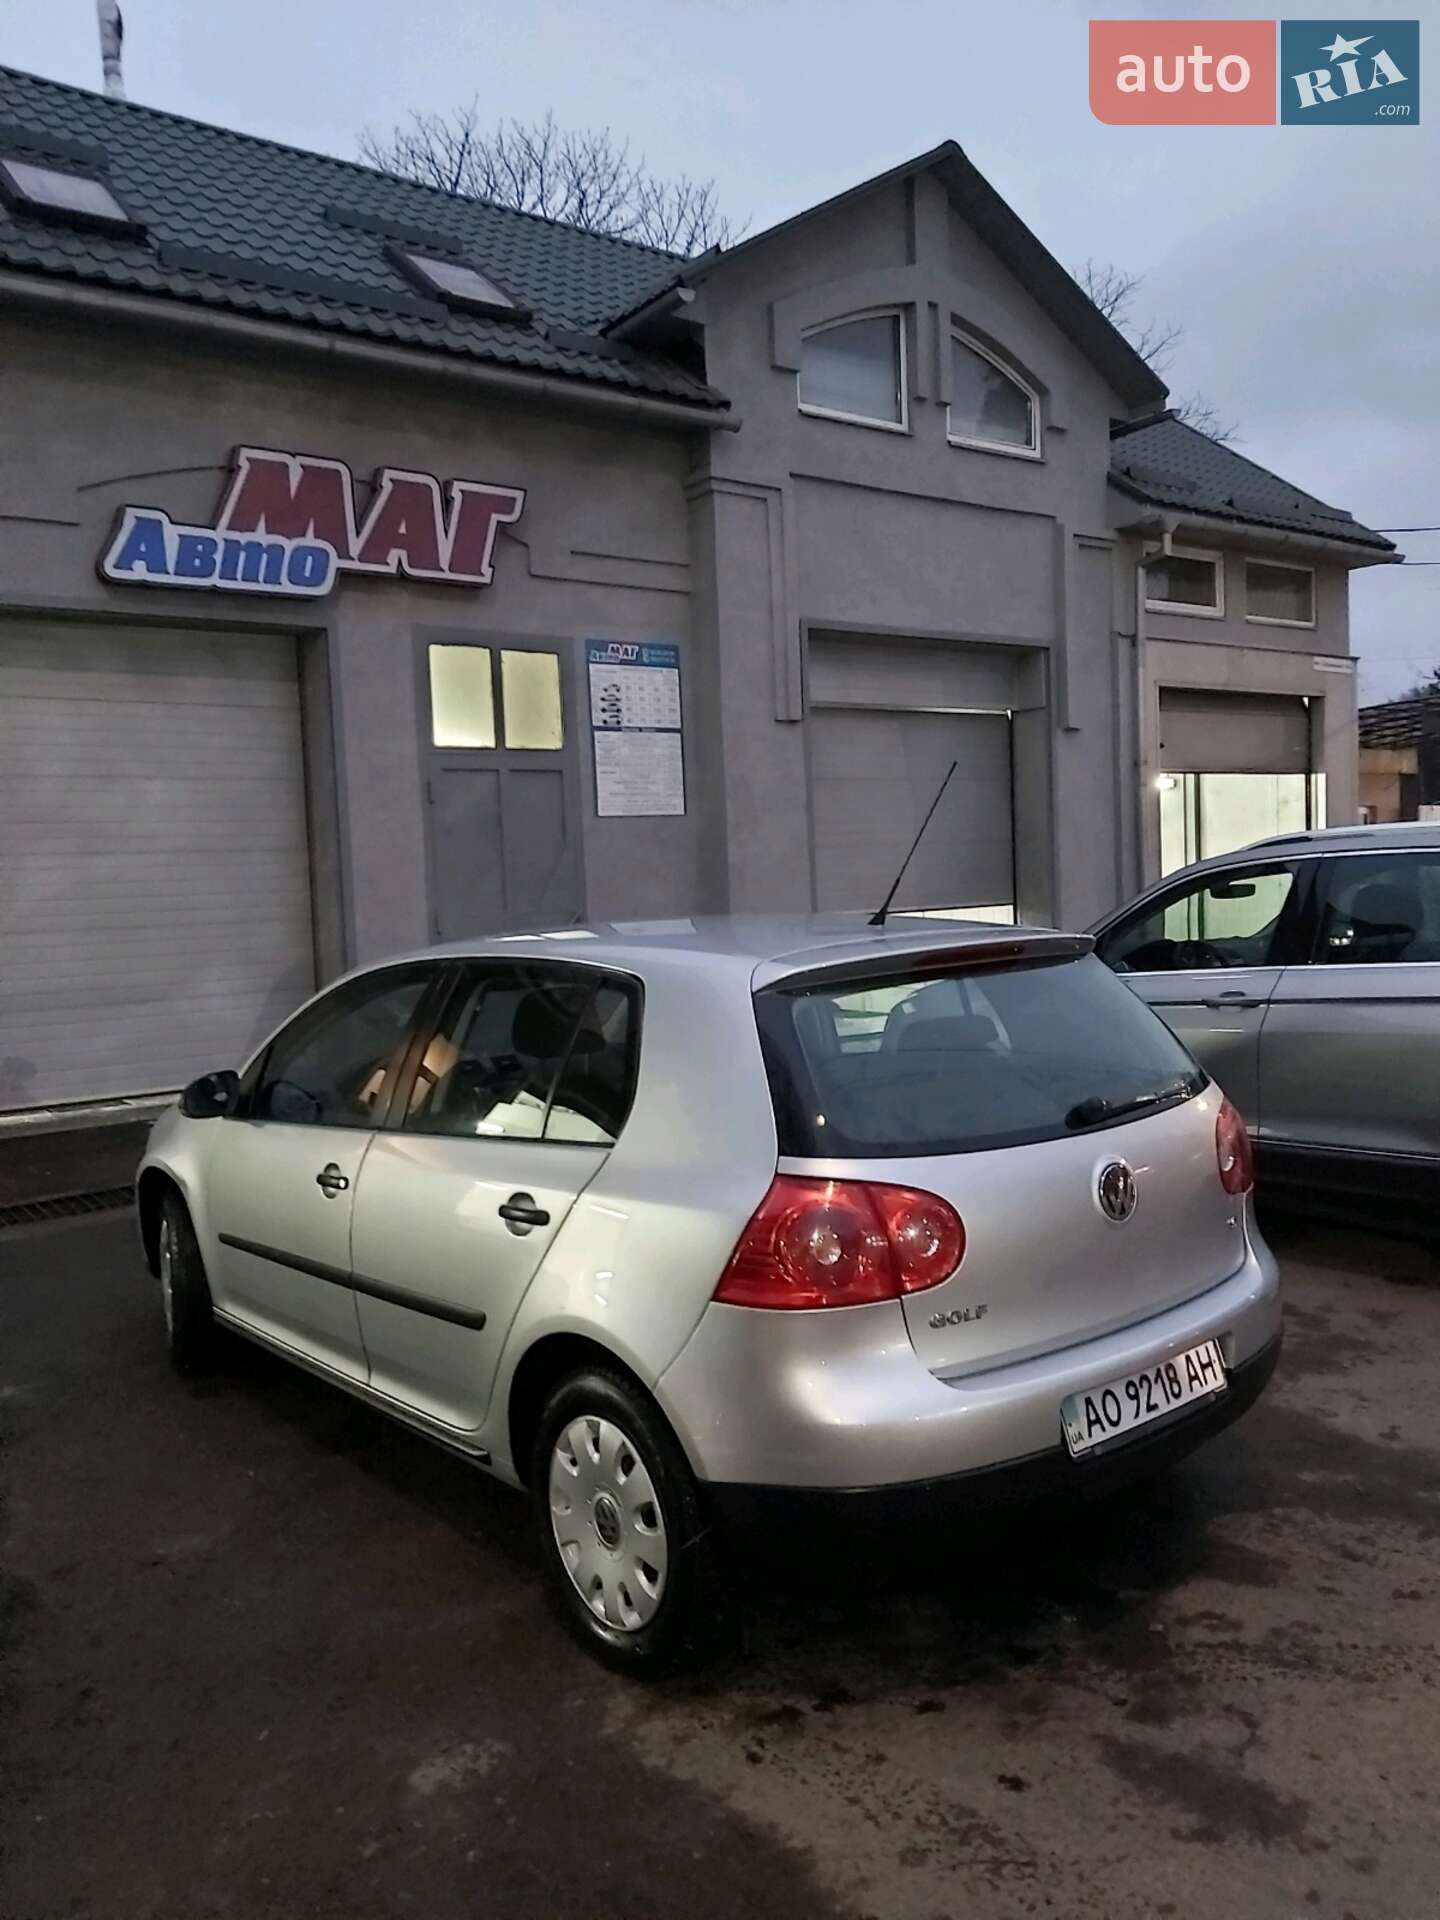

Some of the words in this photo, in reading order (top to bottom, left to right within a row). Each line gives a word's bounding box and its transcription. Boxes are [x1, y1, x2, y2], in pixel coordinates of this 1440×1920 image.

[216, 451, 525, 581] МАГ
[929, 1304, 988, 1328] GOLF
[1084, 1388, 1122, 1438] AO
[1125, 1362, 1182, 1419] 9218
[1184, 1345, 1218, 1392] AH
